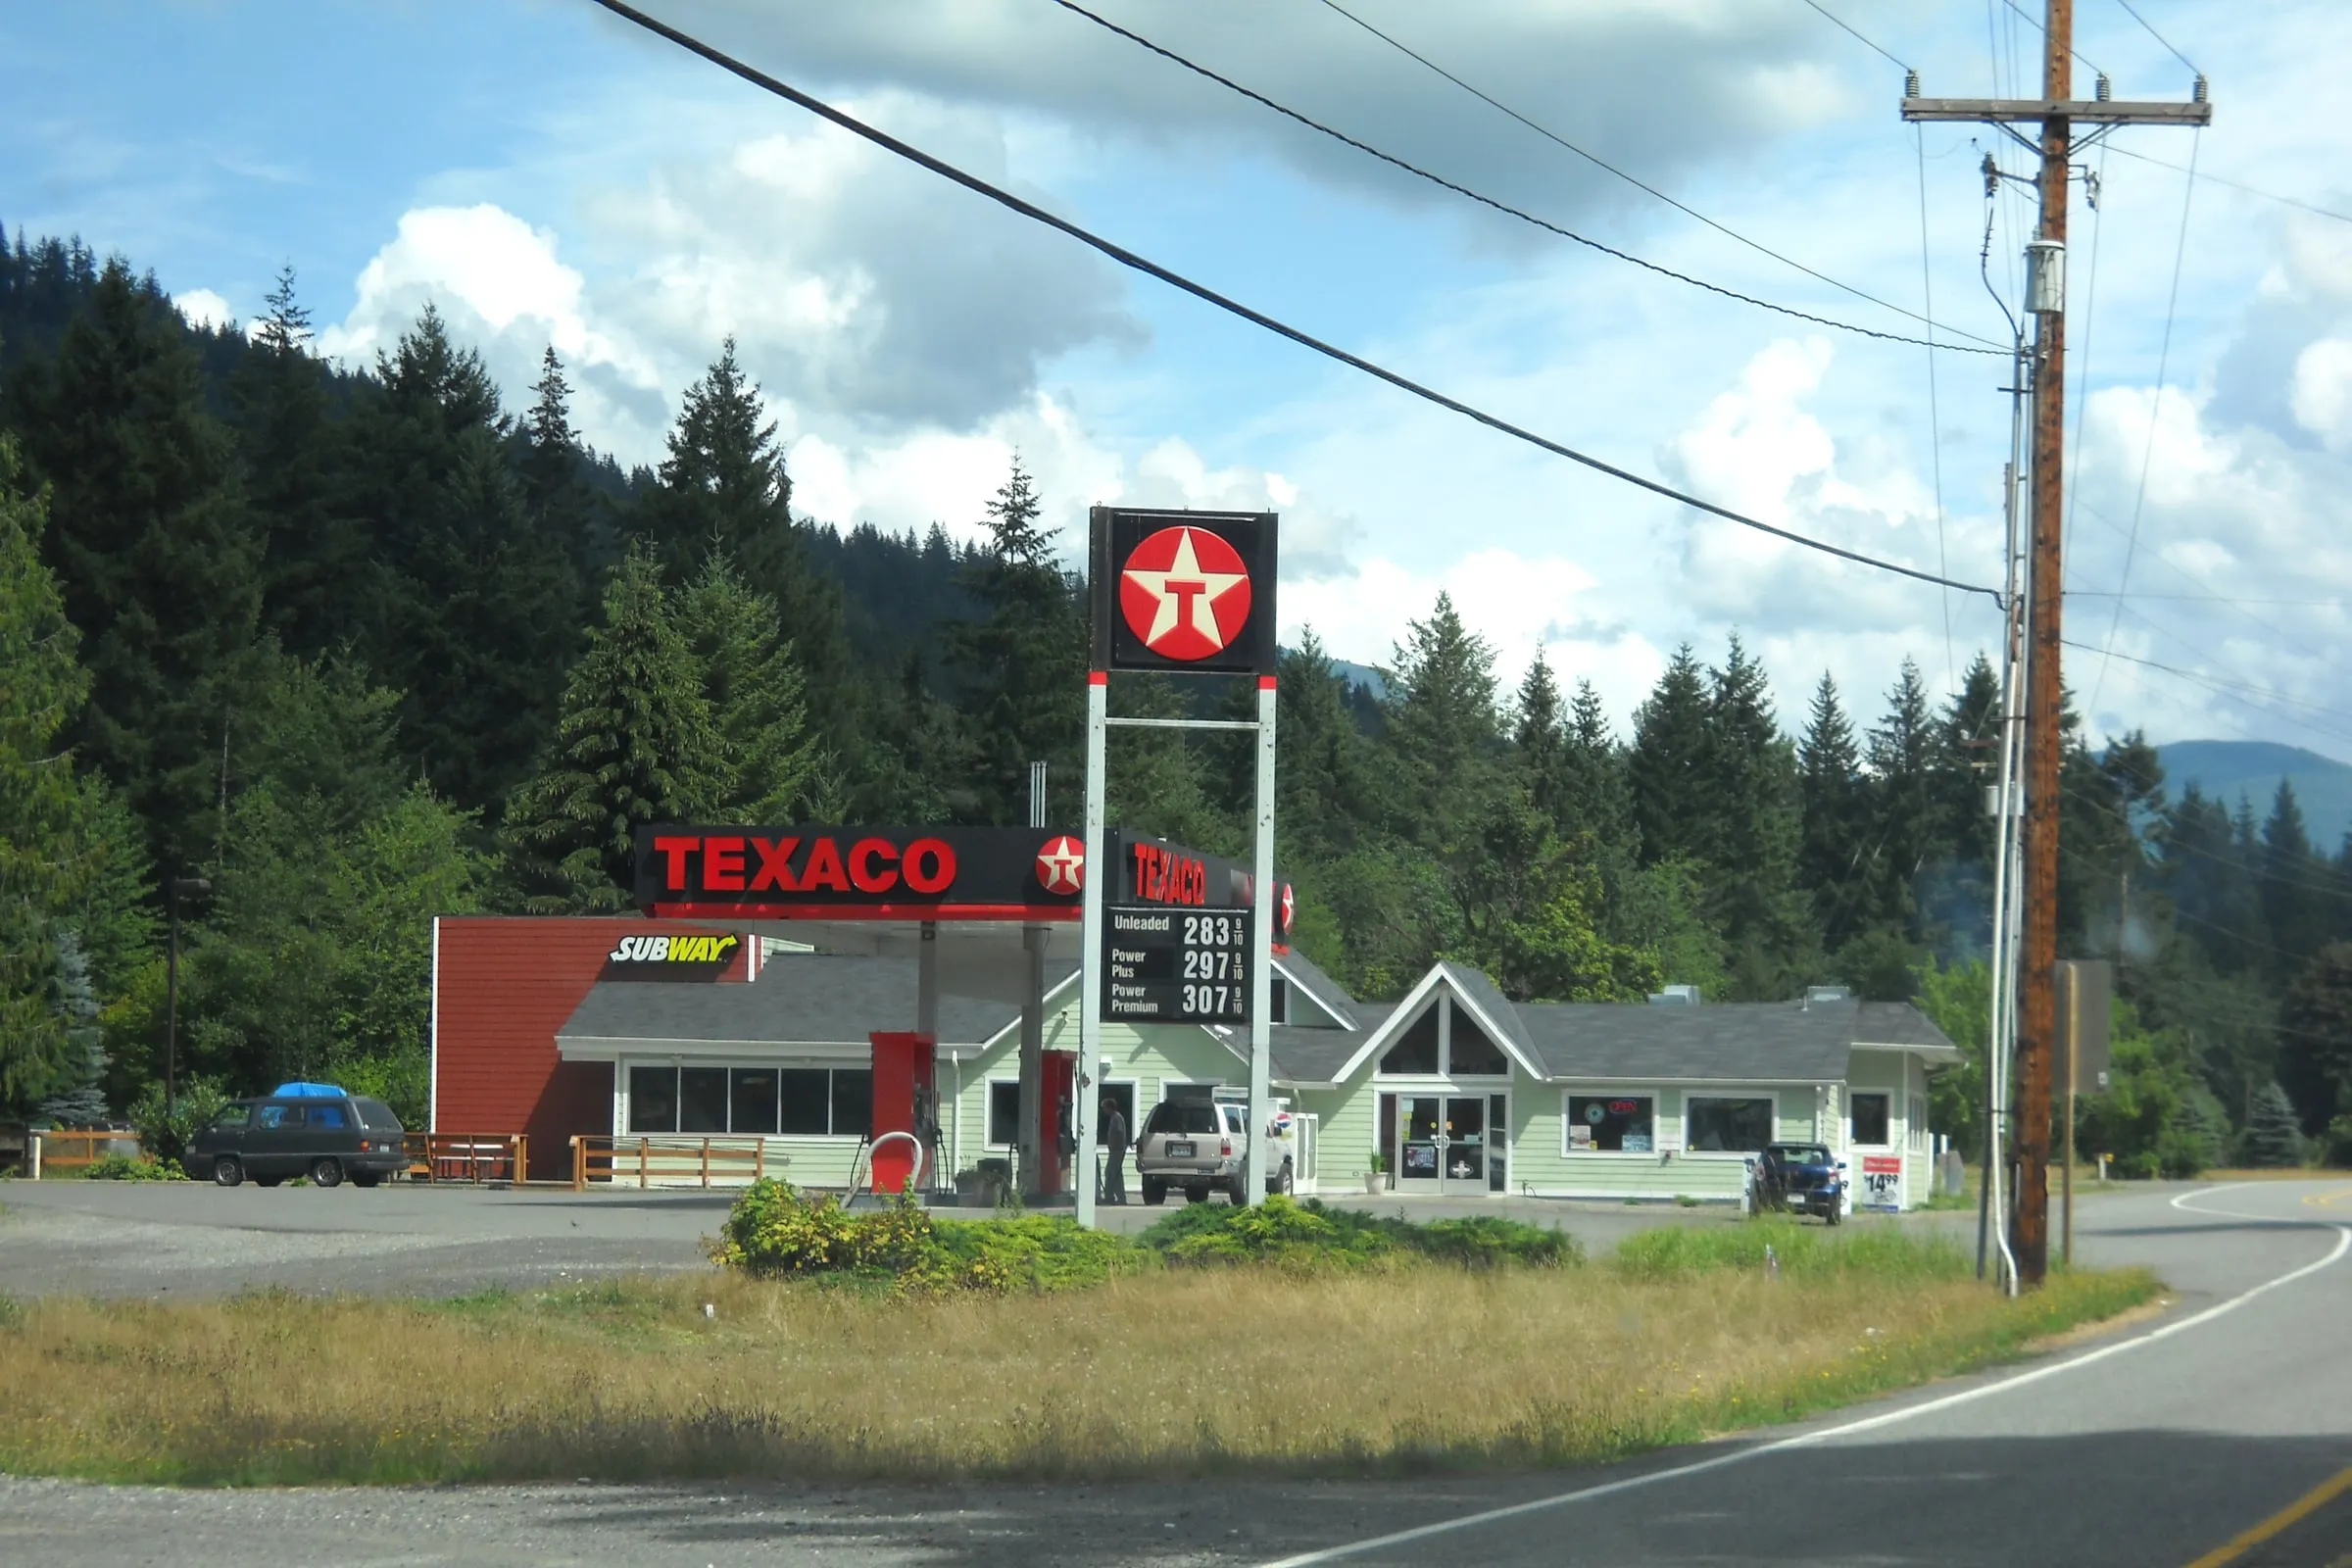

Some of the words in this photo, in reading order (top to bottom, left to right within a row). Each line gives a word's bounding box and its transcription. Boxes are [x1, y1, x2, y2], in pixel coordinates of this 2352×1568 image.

[1164, 579, 1206, 627] T
[655, 836, 956, 894] TEXACO
[1054, 859, 1072, 880] T
[1134, 842, 1206, 906] TEXACO
[1114, 914, 1170, 931] Unleaded
[1184, 916, 1230, 946] 283
[610, 935, 737, 962] SUBWAY
[1111, 948, 1147, 962] Power
[1111, 964, 1135, 978] Plus
[1183, 950, 1229, 980] 297
[1111, 983, 1147, 997] Power
[1182, 984, 1228, 1014] 307
[1111, 999, 1158, 1013] Premium
